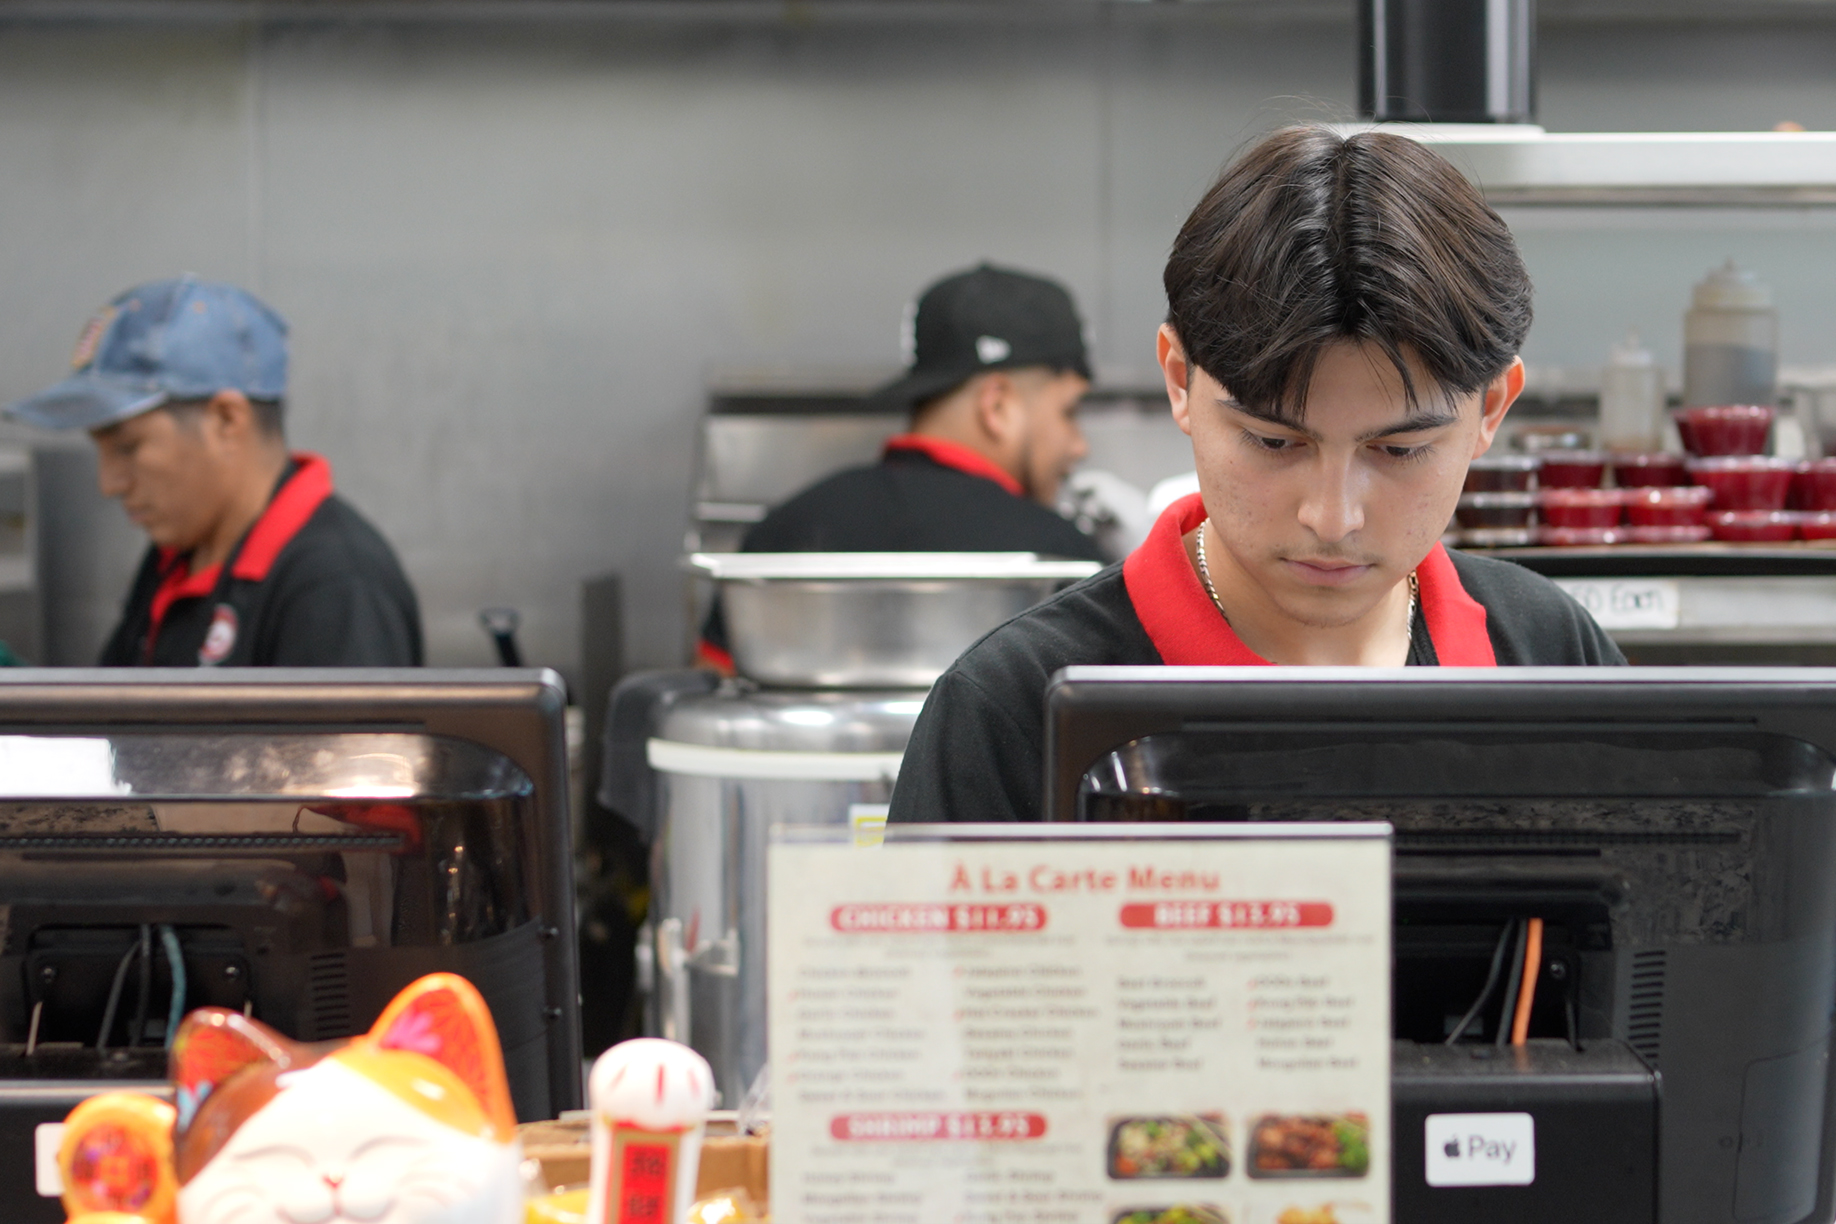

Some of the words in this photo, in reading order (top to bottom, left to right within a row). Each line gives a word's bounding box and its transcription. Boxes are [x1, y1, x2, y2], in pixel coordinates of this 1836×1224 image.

[982, 866, 1018, 892] La
[1029, 865, 1117, 892] Carte
[1129, 866, 1220, 892] Menu
[838, 905, 948, 929] CHICKEN
[955, 905, 1039, 929] $11.95
[1155, 903, 1211, 926] BEEF
[1216, 902, 1300, 926] $13.95
[848, 1114, 940, 1137] SHRIMP
[946, 1114, 1030, 1137] $13.95
[1468, 1135, 1517, 1165] Pay
